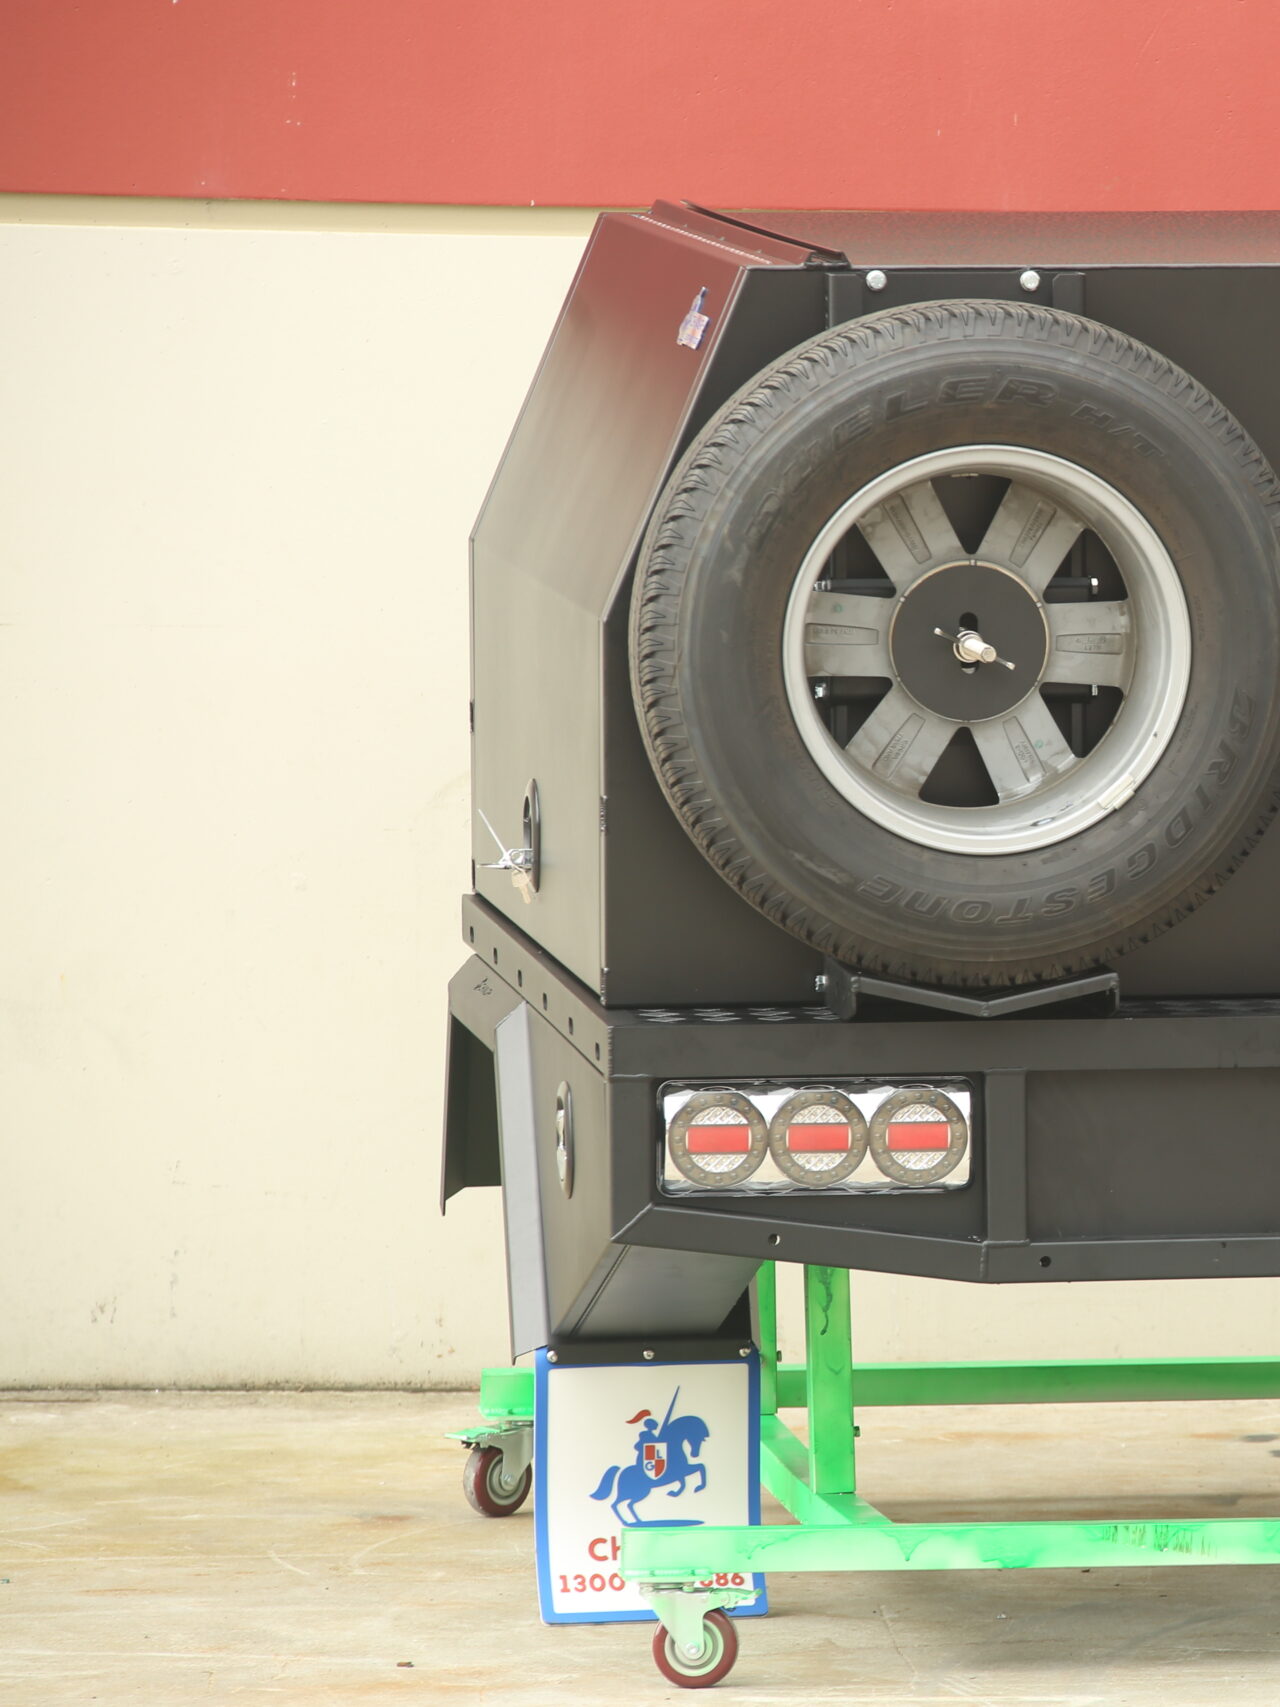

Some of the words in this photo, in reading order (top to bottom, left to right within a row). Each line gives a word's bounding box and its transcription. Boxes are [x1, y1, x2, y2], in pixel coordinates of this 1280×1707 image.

[1070, 402, 1165, 456] H/T
[857, 686, 1256, 926] BRIDGESTONE
[656, 1449, 662, 1459] L
[645, 1461, 655, 1471] G
[559, 1573, 626, 1593] 1300
